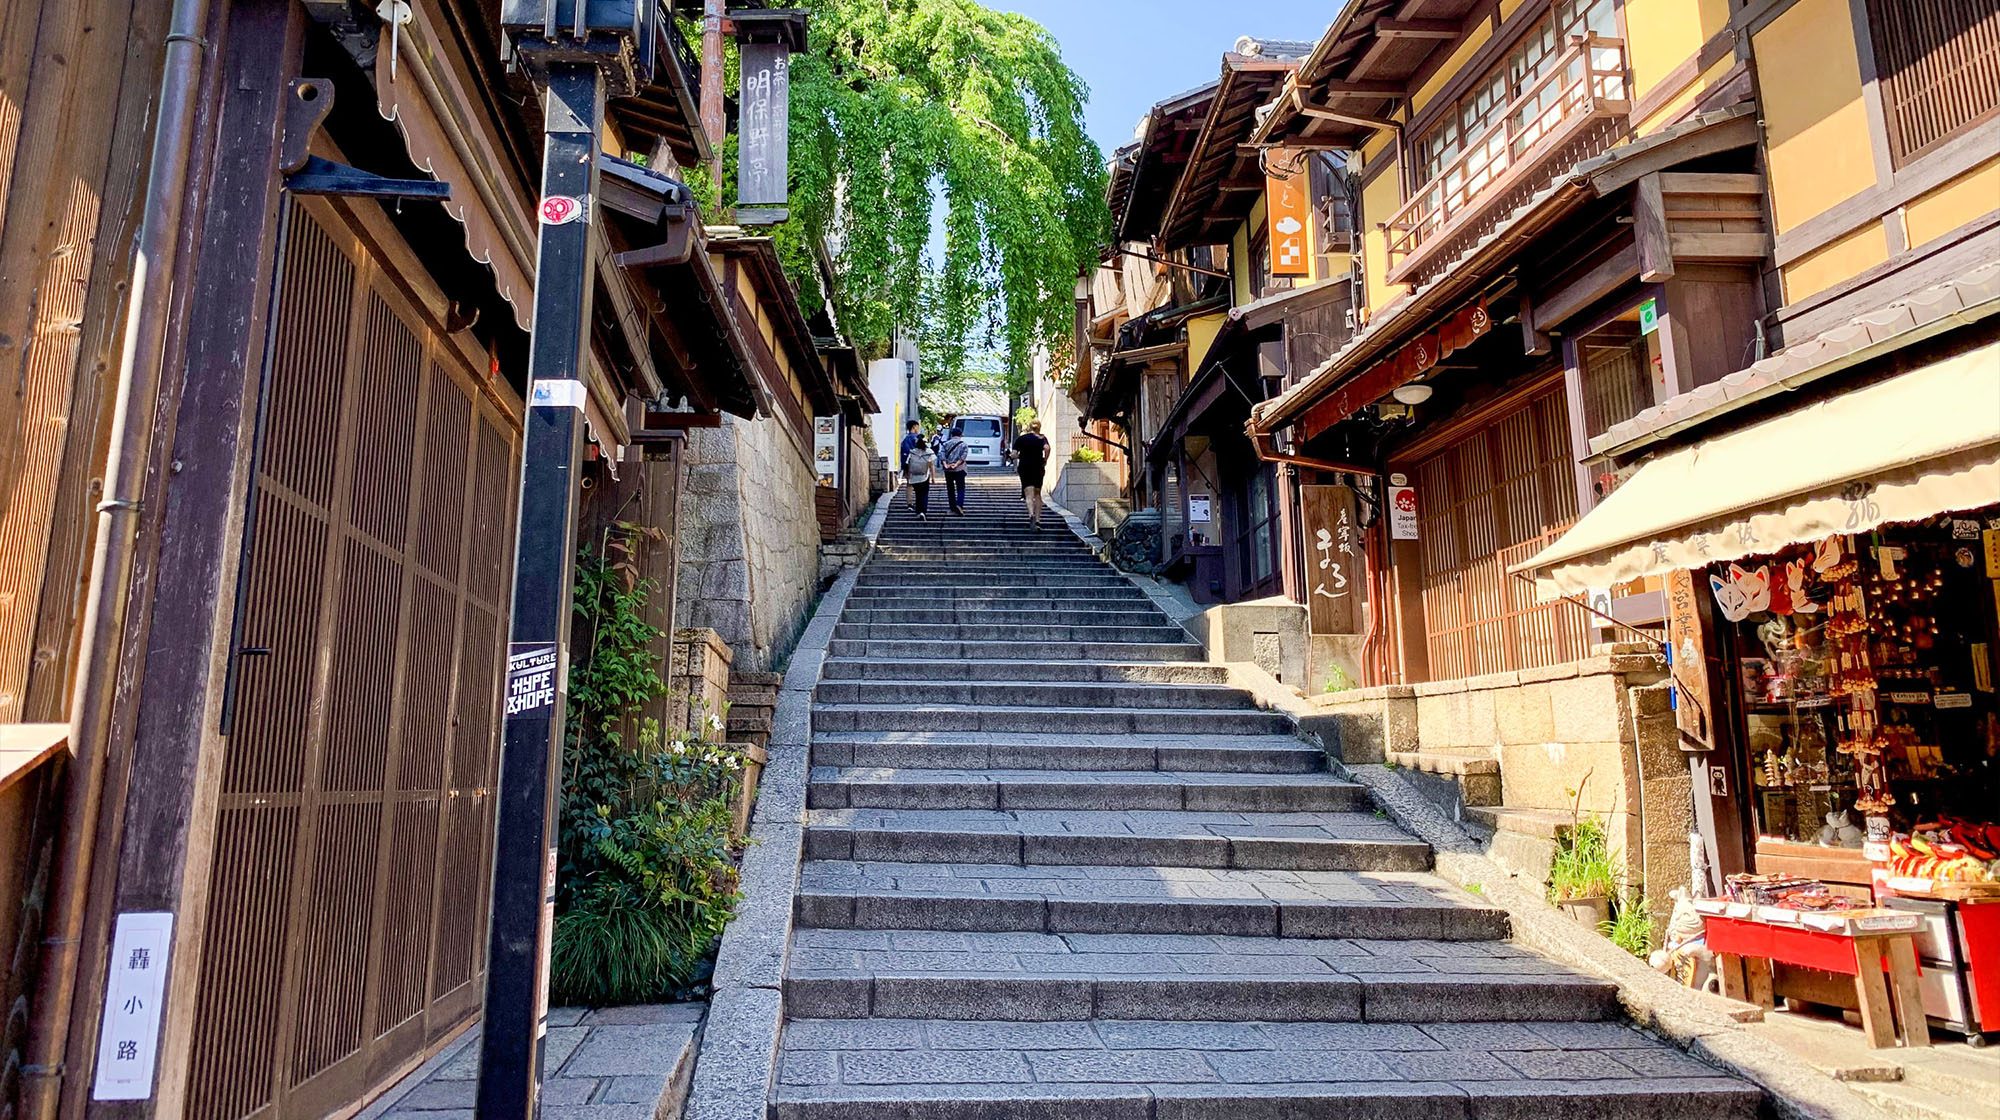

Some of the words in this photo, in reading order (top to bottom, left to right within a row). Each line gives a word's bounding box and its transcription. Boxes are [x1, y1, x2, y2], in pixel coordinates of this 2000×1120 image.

[747, 69, 771, 184] 明保野亭
[509, 653, 557, 671] KULTURE
[512, 671, 551, 695] HYPE
[507, 687, 554, 715] &HOPE
[117, 947, 151, 1061] 轟小路
